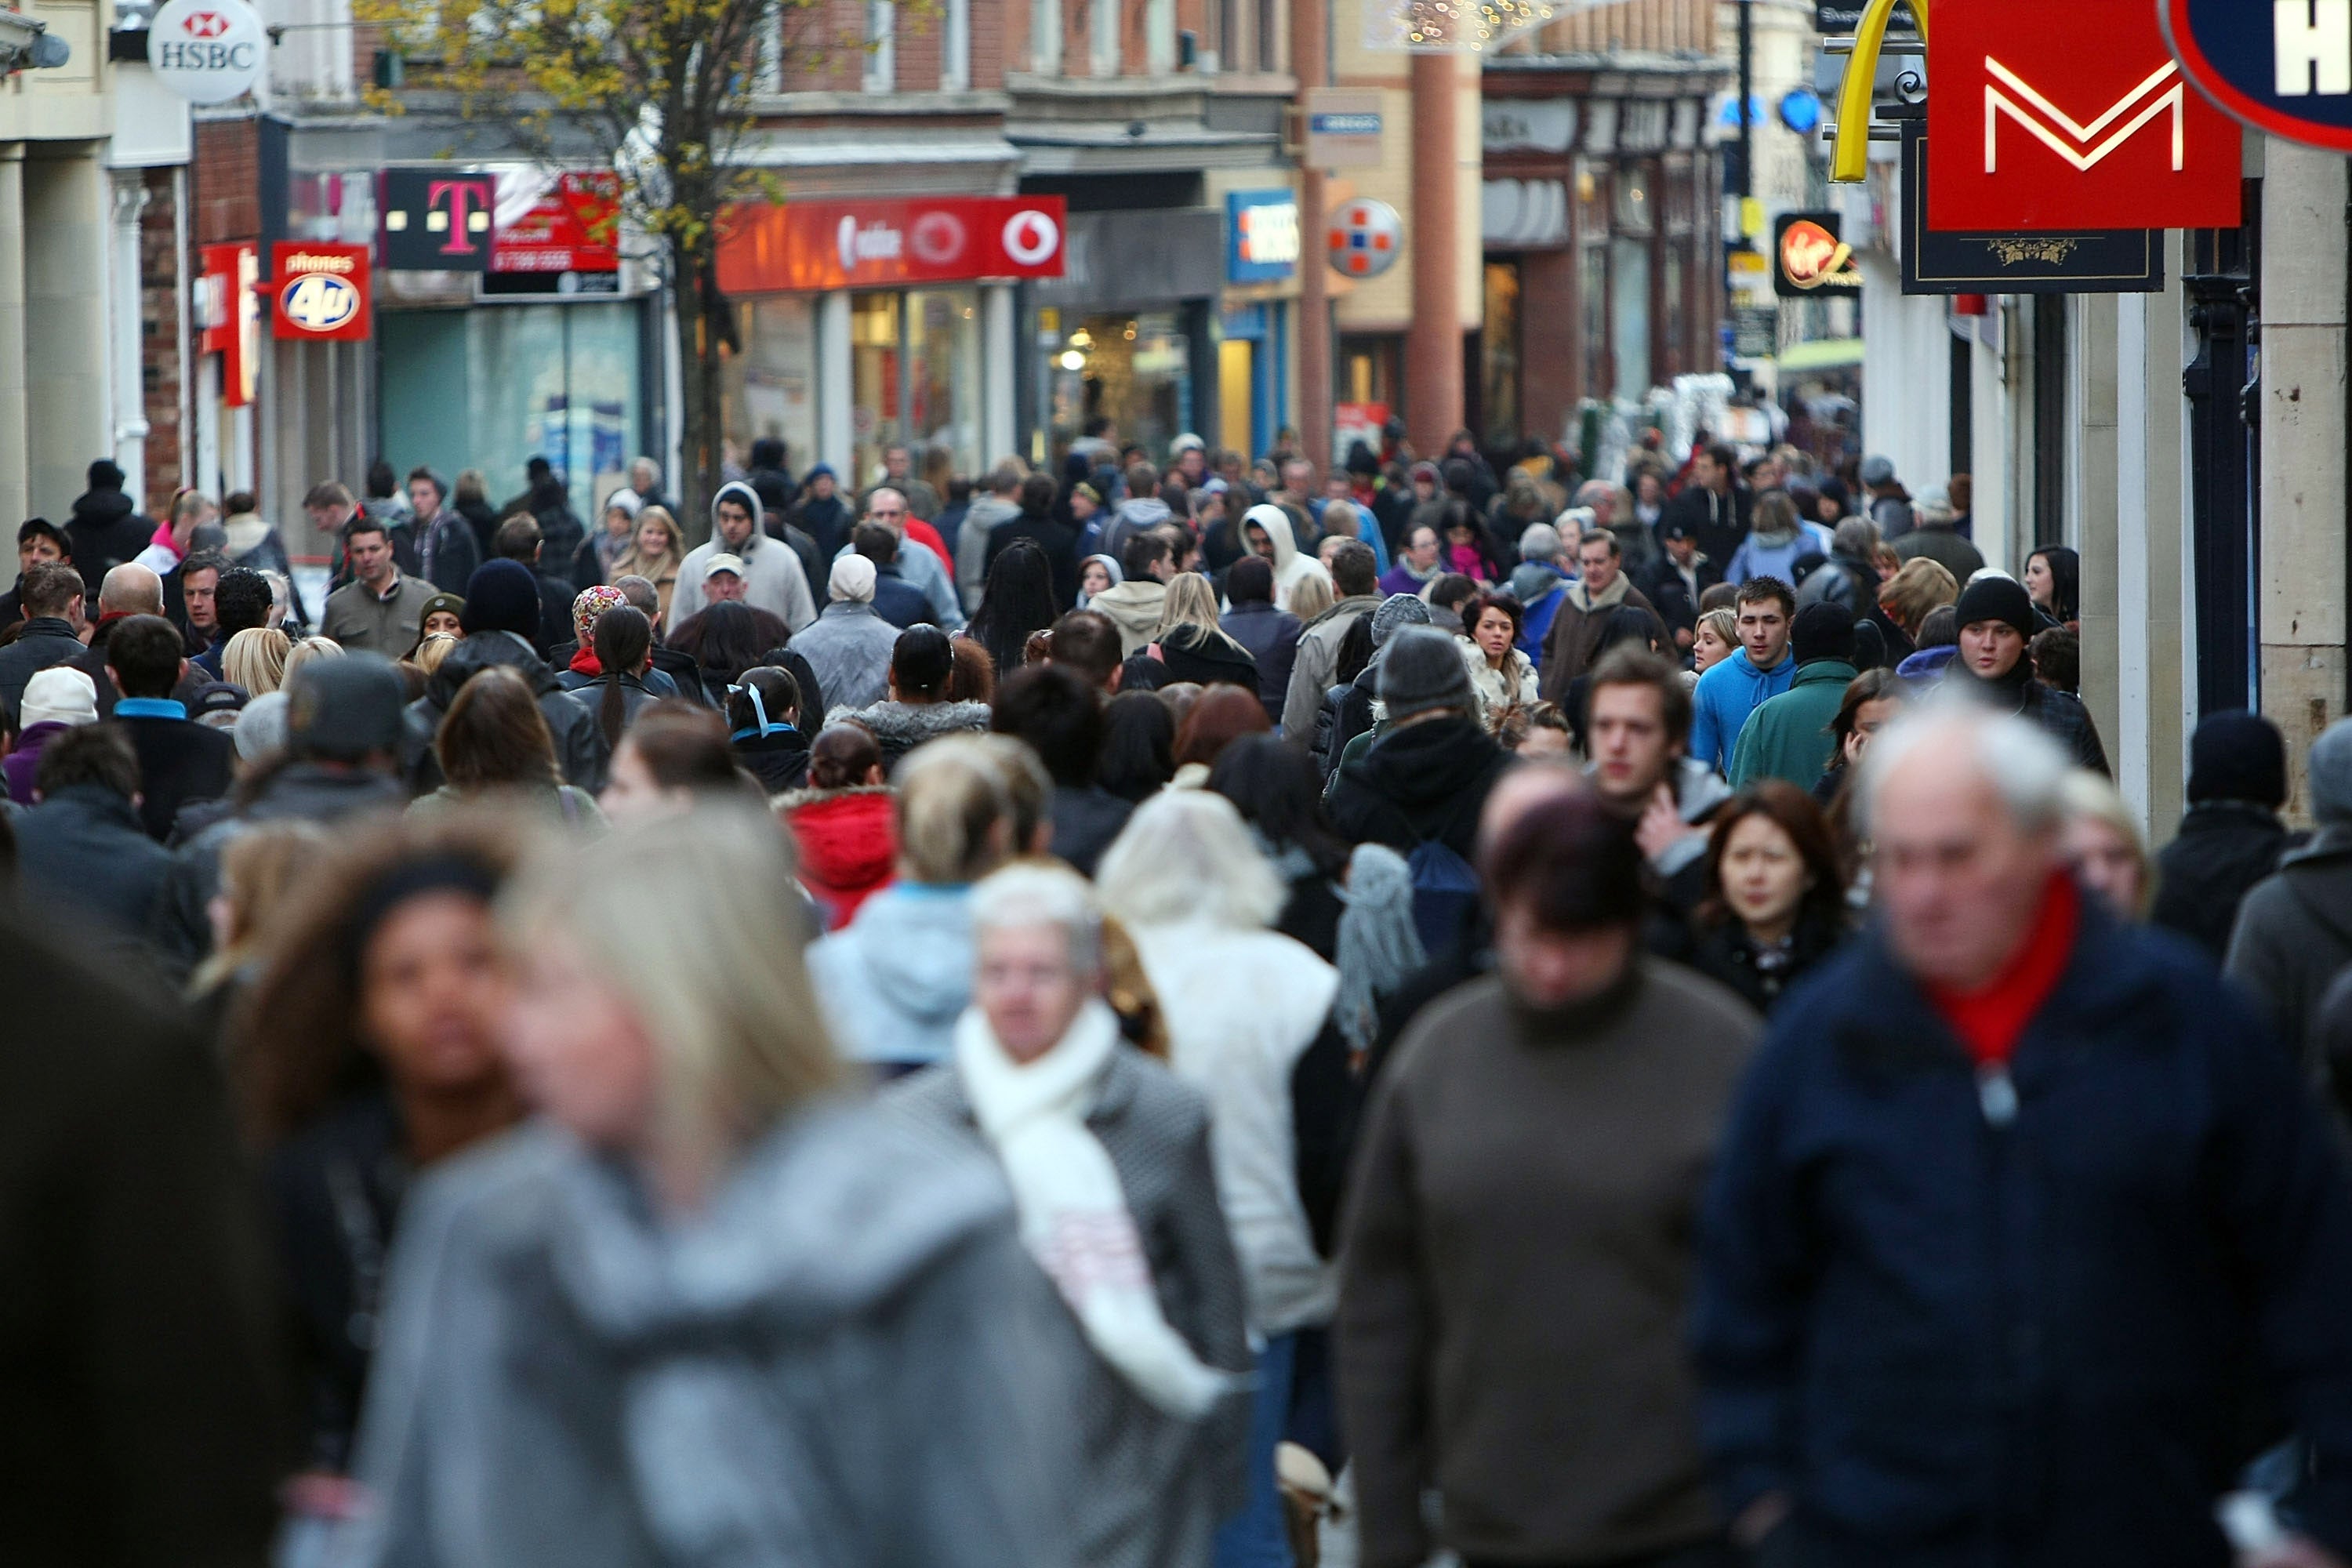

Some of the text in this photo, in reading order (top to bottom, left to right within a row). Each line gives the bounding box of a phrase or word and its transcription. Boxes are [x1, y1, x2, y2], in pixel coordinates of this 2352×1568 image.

[162, 42, 254, 71] HSBC
[429, 181, 488, 255] T
[285, 251, 354, 274] phones
